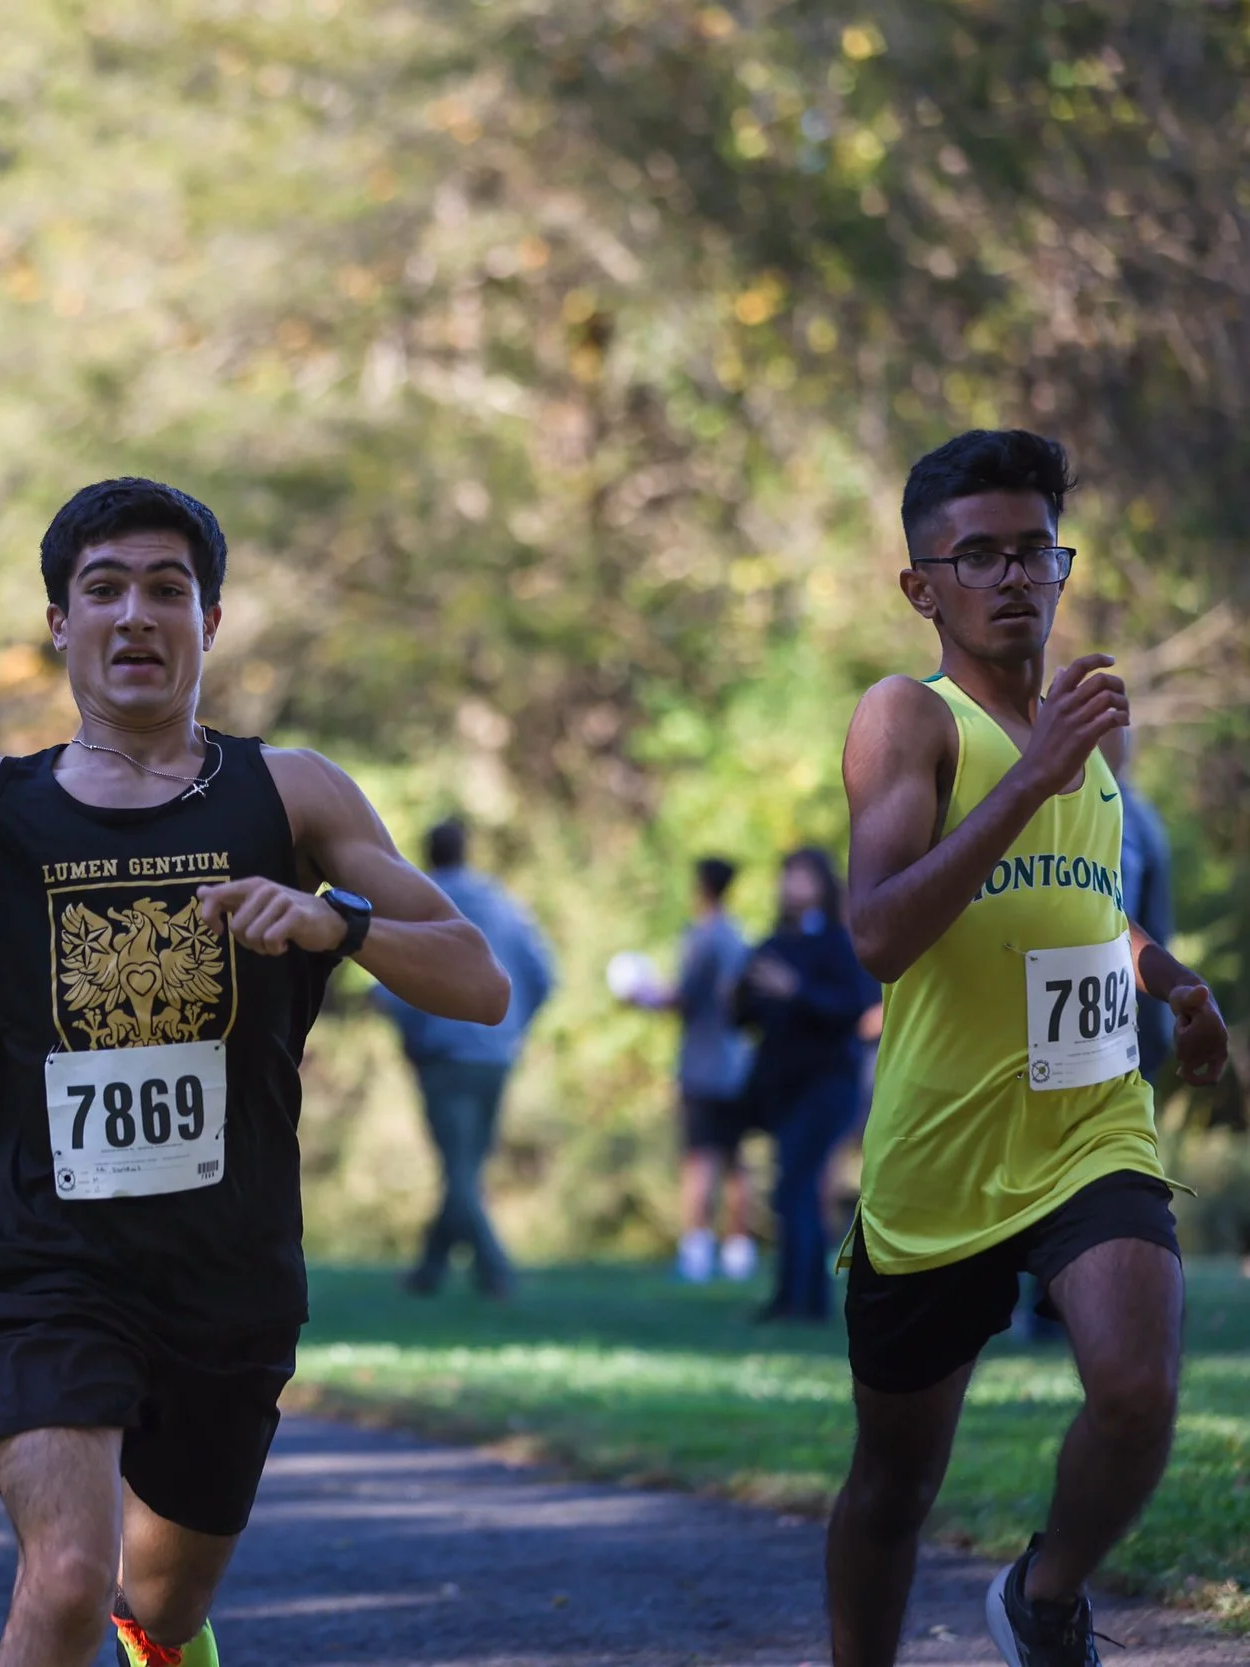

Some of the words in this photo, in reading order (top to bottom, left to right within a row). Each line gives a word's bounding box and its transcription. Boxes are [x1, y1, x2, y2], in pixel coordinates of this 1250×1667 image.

[42, 859, 118, 883] LUMEN
[129, 852, 230, 875] GENTIUM
[1046, 967, 1129, 1043] 7892
[67, 1074, 205, 1150] 7869
